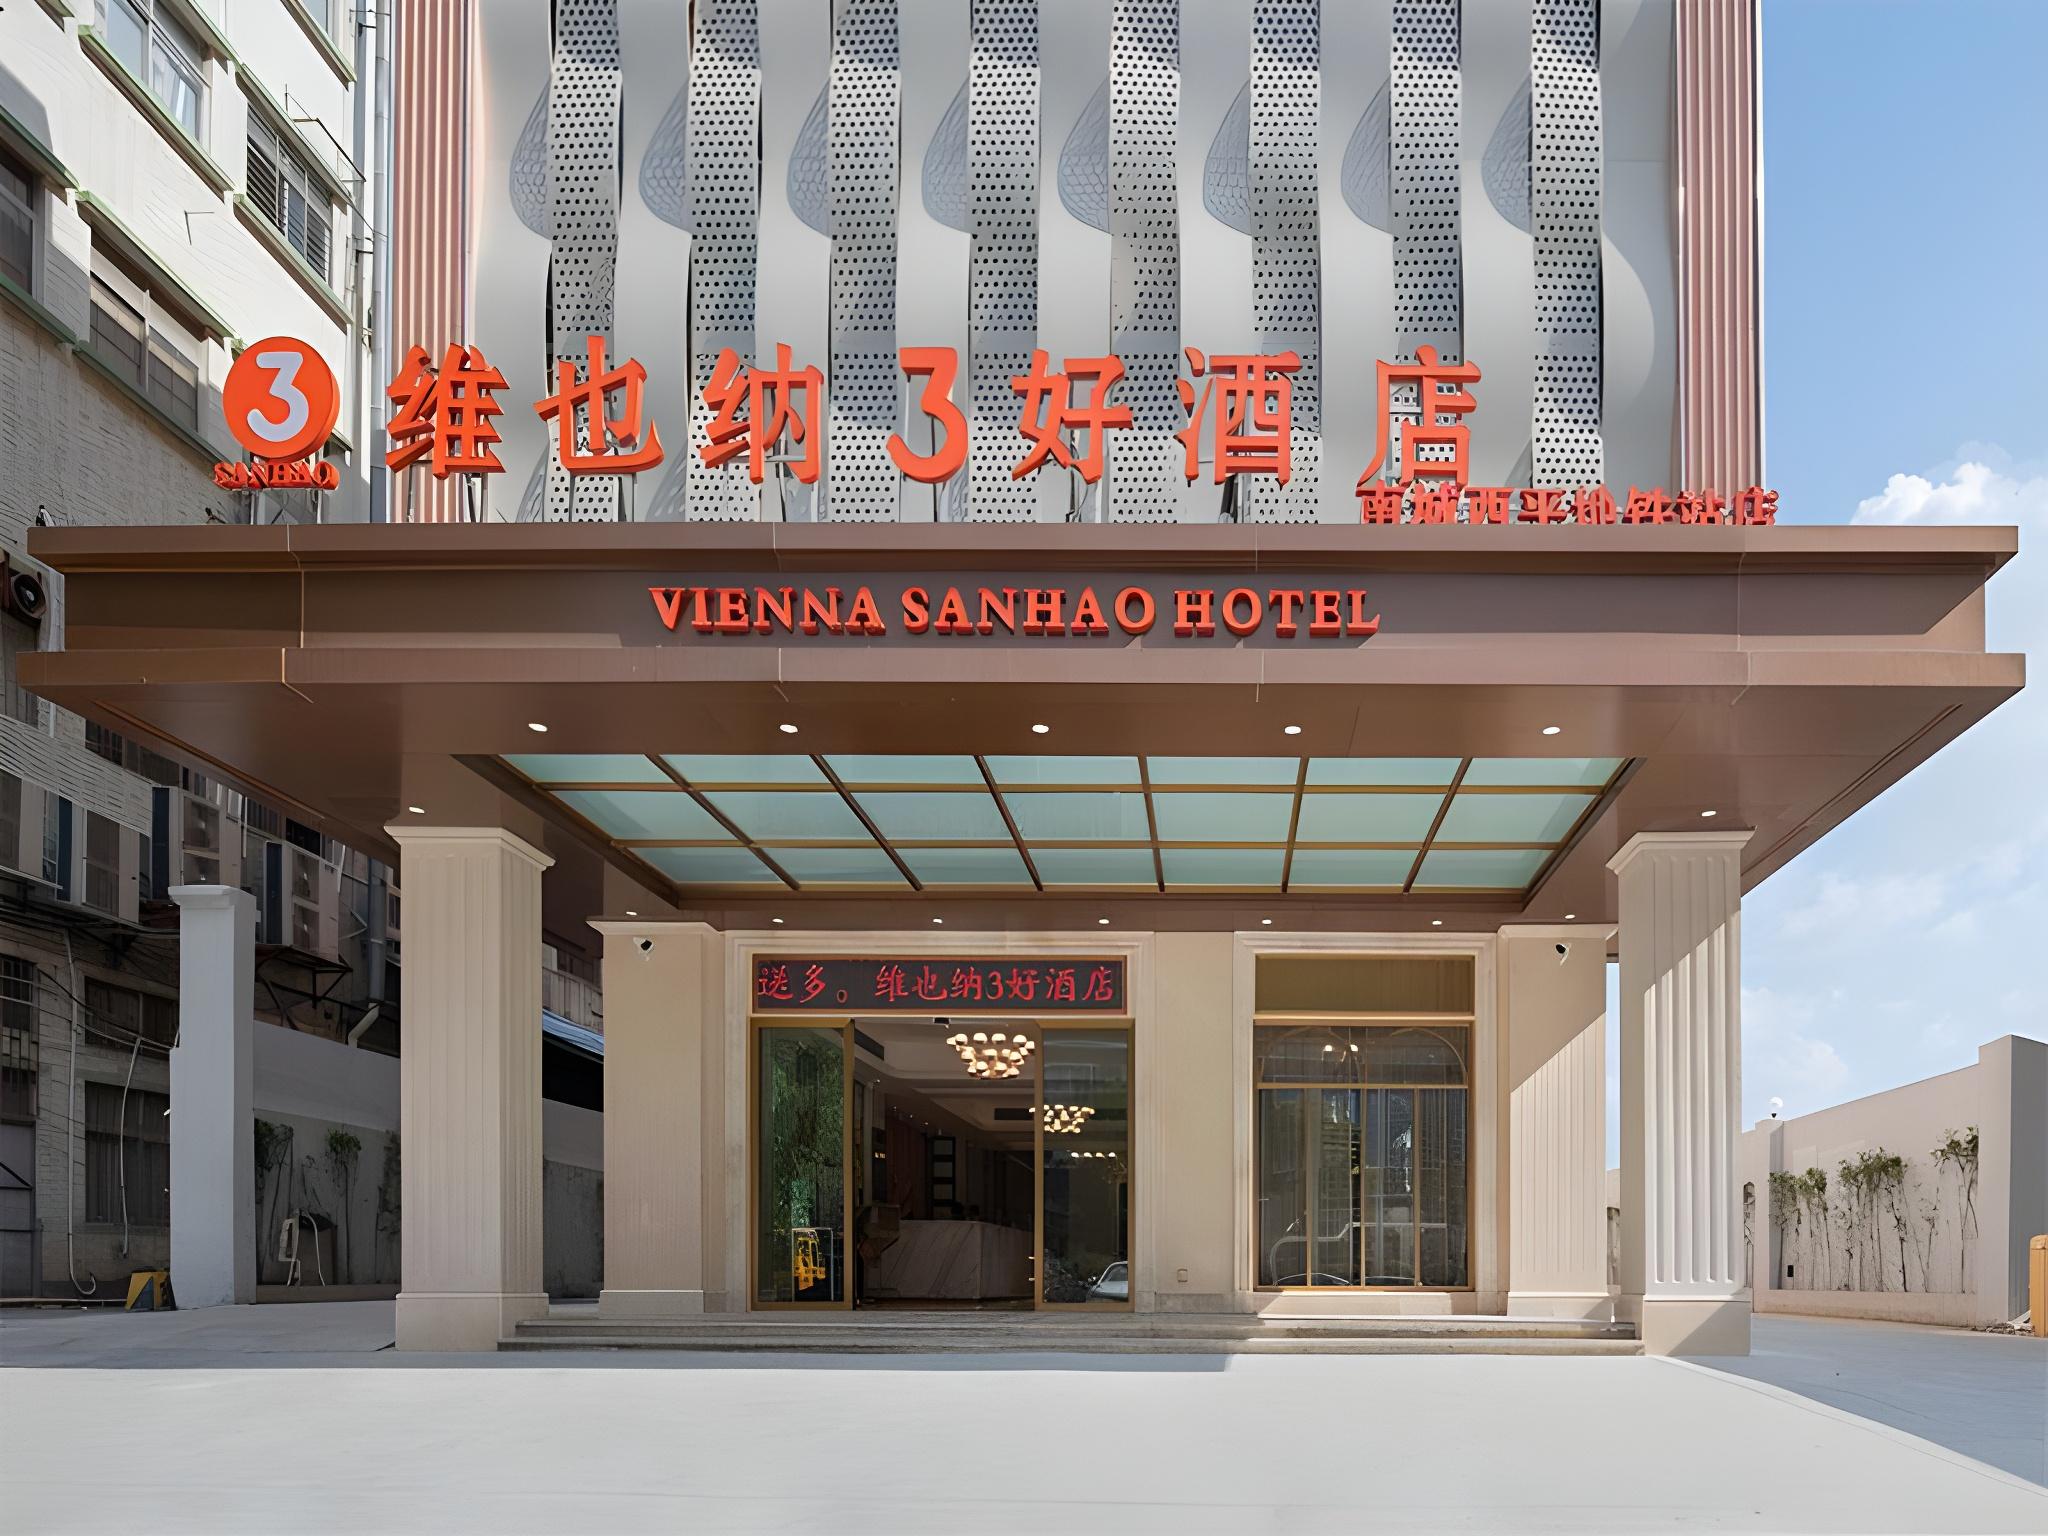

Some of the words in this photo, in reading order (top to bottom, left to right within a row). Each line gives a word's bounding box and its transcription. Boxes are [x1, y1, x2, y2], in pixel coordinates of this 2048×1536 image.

[247, 351, 309, 442] 3
[385, 335, 1482, 487] 维也纳3好酒店
[649, 586, 886, 634] VIENNA
[901, 586, 1156, 636] SANHAO
[1174, 587, 1381, 636] HOTEL
